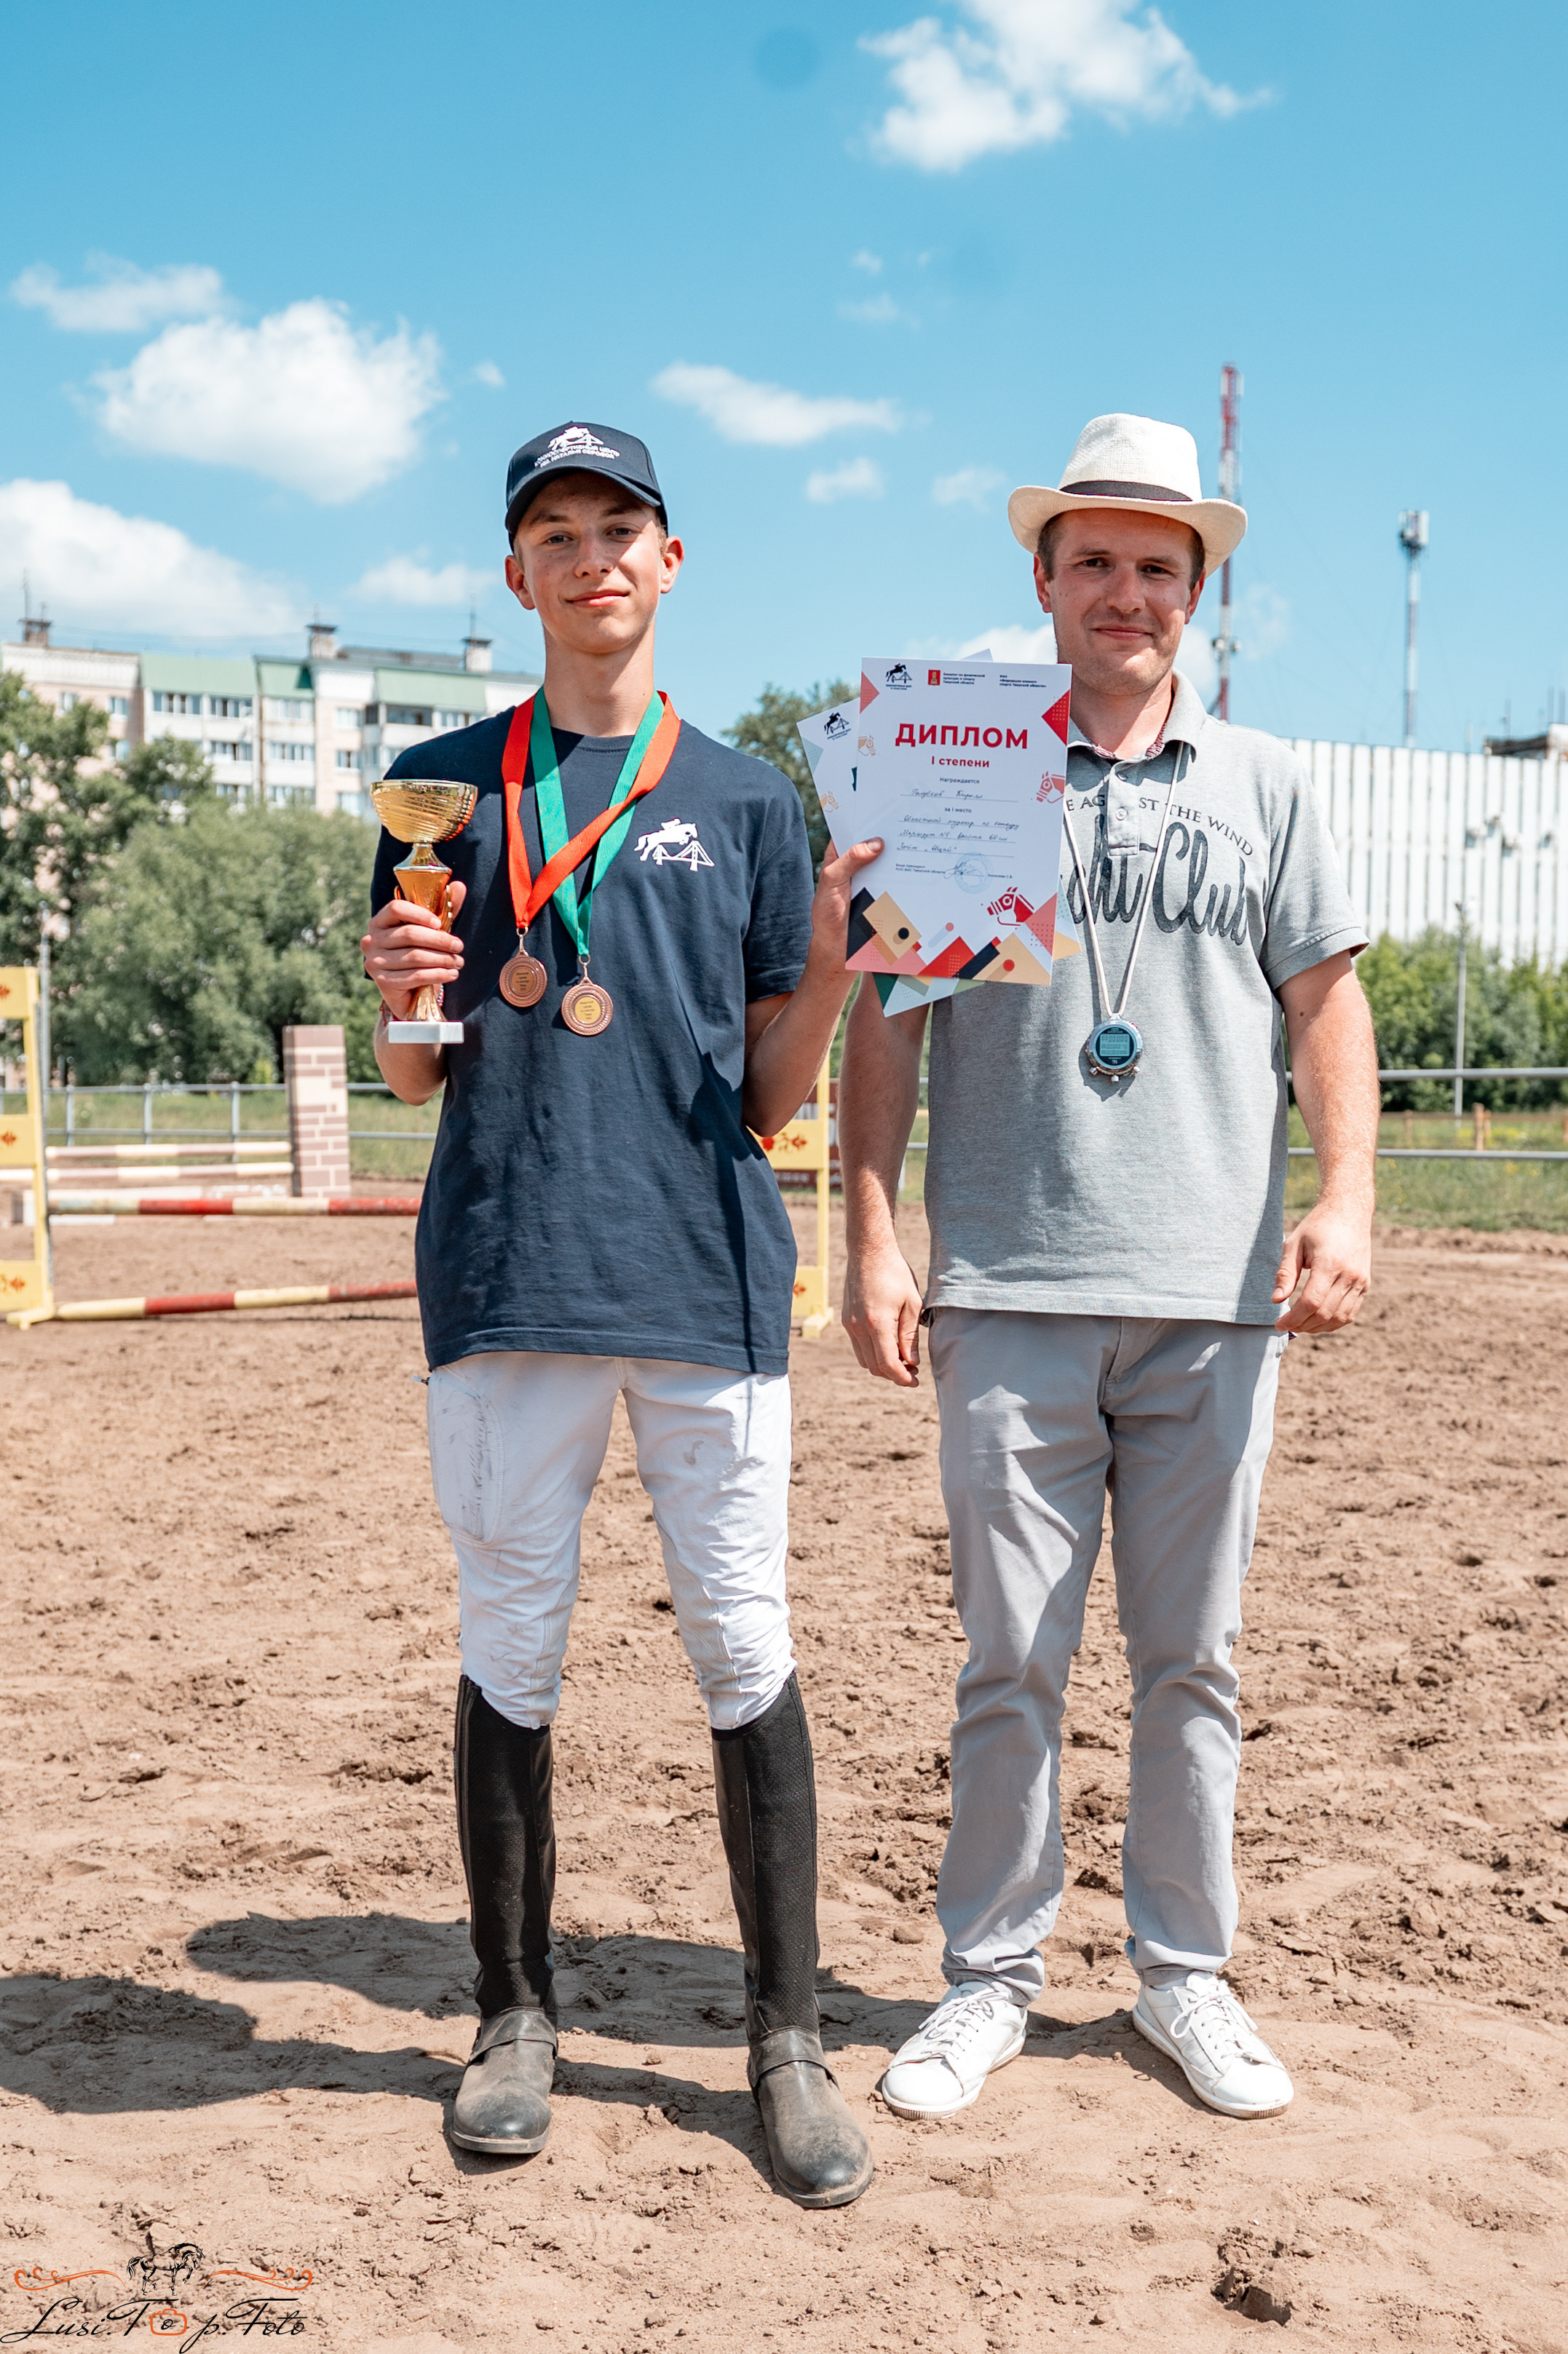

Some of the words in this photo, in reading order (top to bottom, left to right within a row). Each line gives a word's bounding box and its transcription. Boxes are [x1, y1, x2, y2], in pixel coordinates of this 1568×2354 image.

[895, 723, 1028, 749] ДИПЛОМ
[938, 757, 990, 768] степени
[1165, 802, 1202, 823] THE
[1207, 815, 1254, 856] WIND
